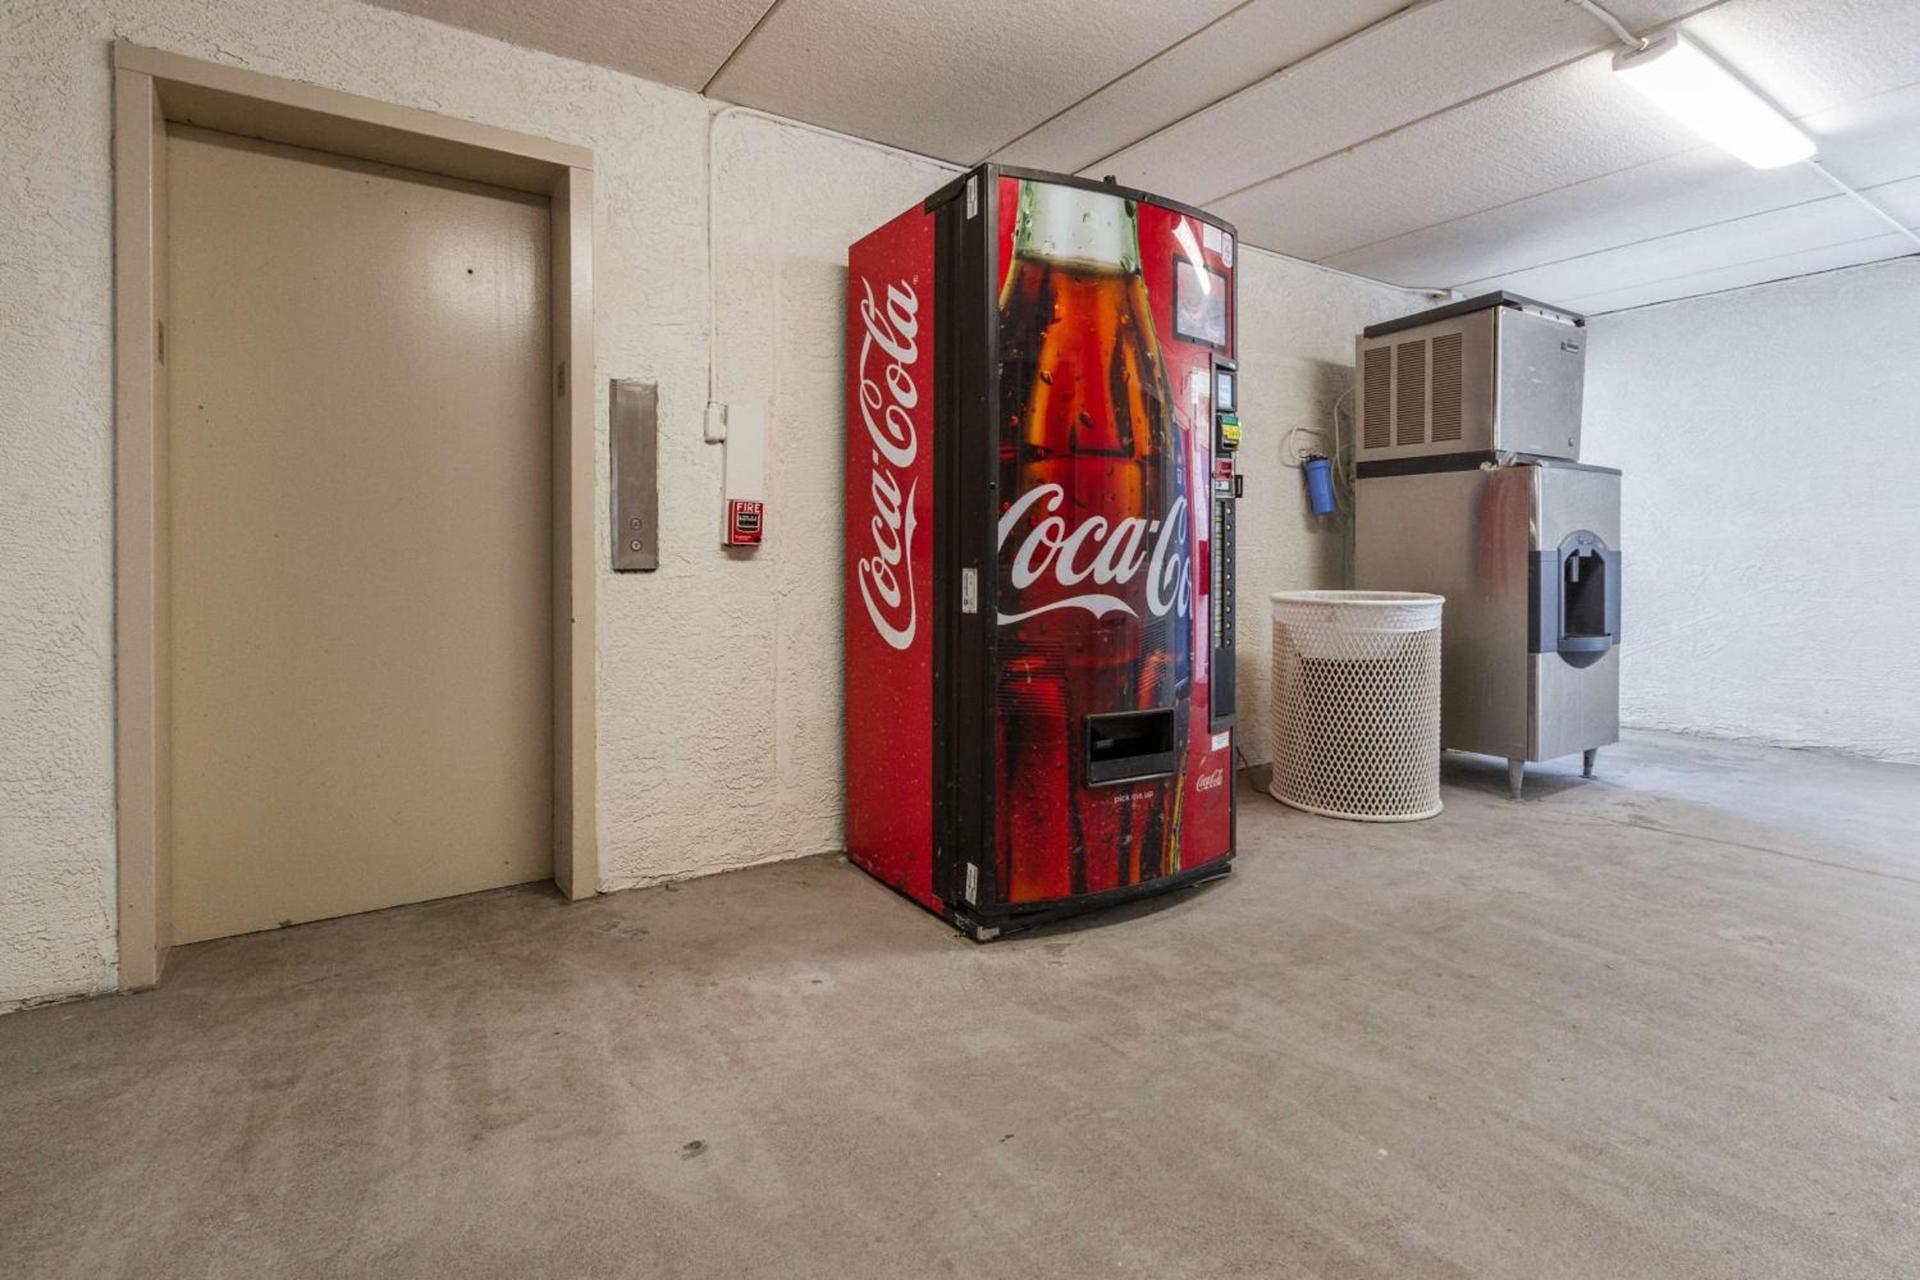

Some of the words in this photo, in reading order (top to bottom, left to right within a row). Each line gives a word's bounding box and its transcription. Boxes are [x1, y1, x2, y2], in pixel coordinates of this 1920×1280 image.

[859, 276, 919, 650] Coca-Cola
[737, 502, 760, 513] FIRE
[1196, 768, 1223, 792] Coca-Cola
